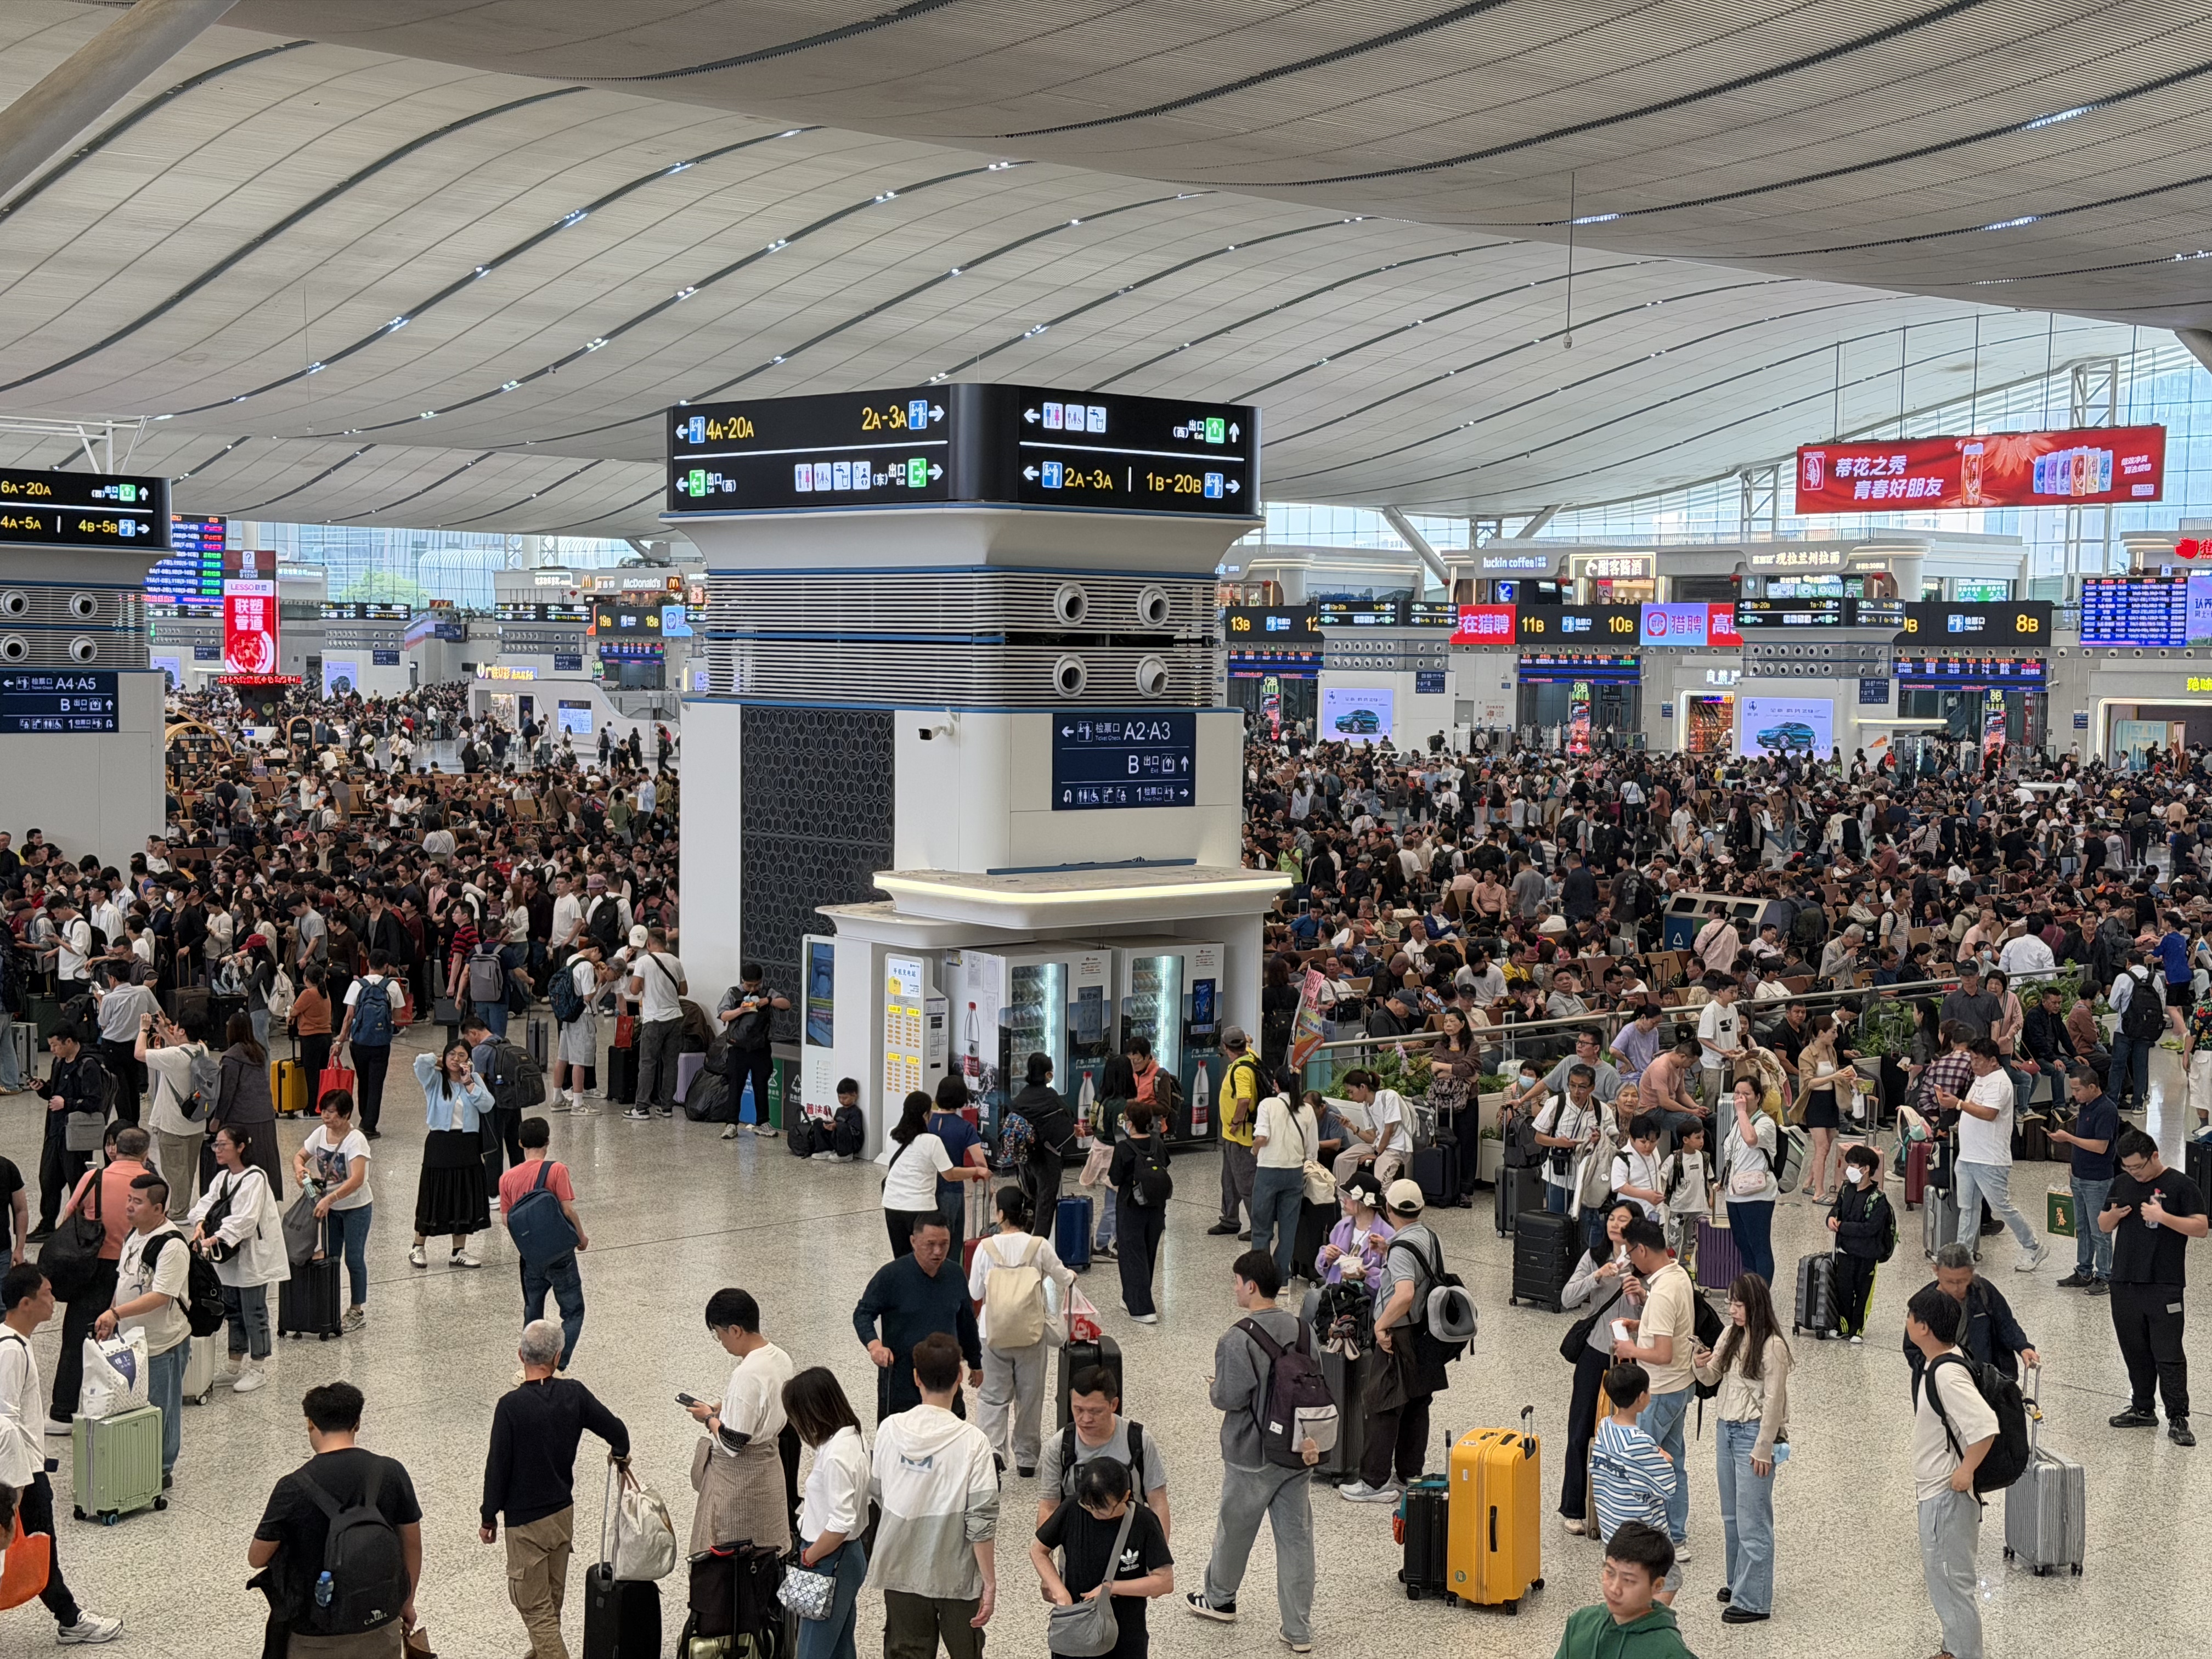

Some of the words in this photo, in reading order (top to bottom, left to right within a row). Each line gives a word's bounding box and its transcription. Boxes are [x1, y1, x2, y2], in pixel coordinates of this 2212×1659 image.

[862, 405, 907, 430] 2A-3A
[706, 417, 754, 440] 4A-20A
[1189, 420, 1204, 431] 出口
[1835, 455, 1906, 477] 蒂花之秀
[707, 472, 721, 486] 出口
[873, 472, 888, 487] (东)
[888, 463, 905, 477] 出口
[1065, 468, 1113, 490] 2A-3A
[1147, 472, 1201, 493] 1B-20B
[1, 481, 52, 495] 6A-20A
[105, 486, 118, 494] 出口
[1854, 478, 1944, 500] 青春好朋友
[0, 515, 41, 531] 4A-5A
[78, 520, 117, 533] 4B-5B
[1483, 557, 1507, 568] luckin
[1509, 557, 1534, 568] coffee
[1776, 551, 1839, 565] 现拉兰州拉面
[623, 578, 661, 589] McDonald's
[235, 599, 263, 614] 联塑
[235, 615, 263, 630] 管道
[599, 616, 612, 627] 19B
[646, 616, 659, 627] 18B
[1231, 616, 1250, 631] 13B
[1306, 616, 1320, 631] 12
[1458, 614, 1509, 634] 在猎聘
[1522, 617, 1544, 632] 11B
[1609, 616, 1633, 633] 10B
[1672, 615, 1702, 634] 猎聘
[1904, 617, 1918, 633] B
[1965, 617, 1985, 625] 检票口
[2016, 614, 2039, 633] 8B
[1990, 691, 2002, 701] 8B
[61, 698, 70, 711] B
[69, 720, 73, 729] 1
[1096, 723, 1120, 733] 检票口
[1128, 755, 1139, 774] B
[1143, 755, 1159, 766] 出口
[1137, 787, 1142, 802] 1
[1144, 787, 1163, 795] 检票口
[893, 967, 916, 978] 手机充电站
